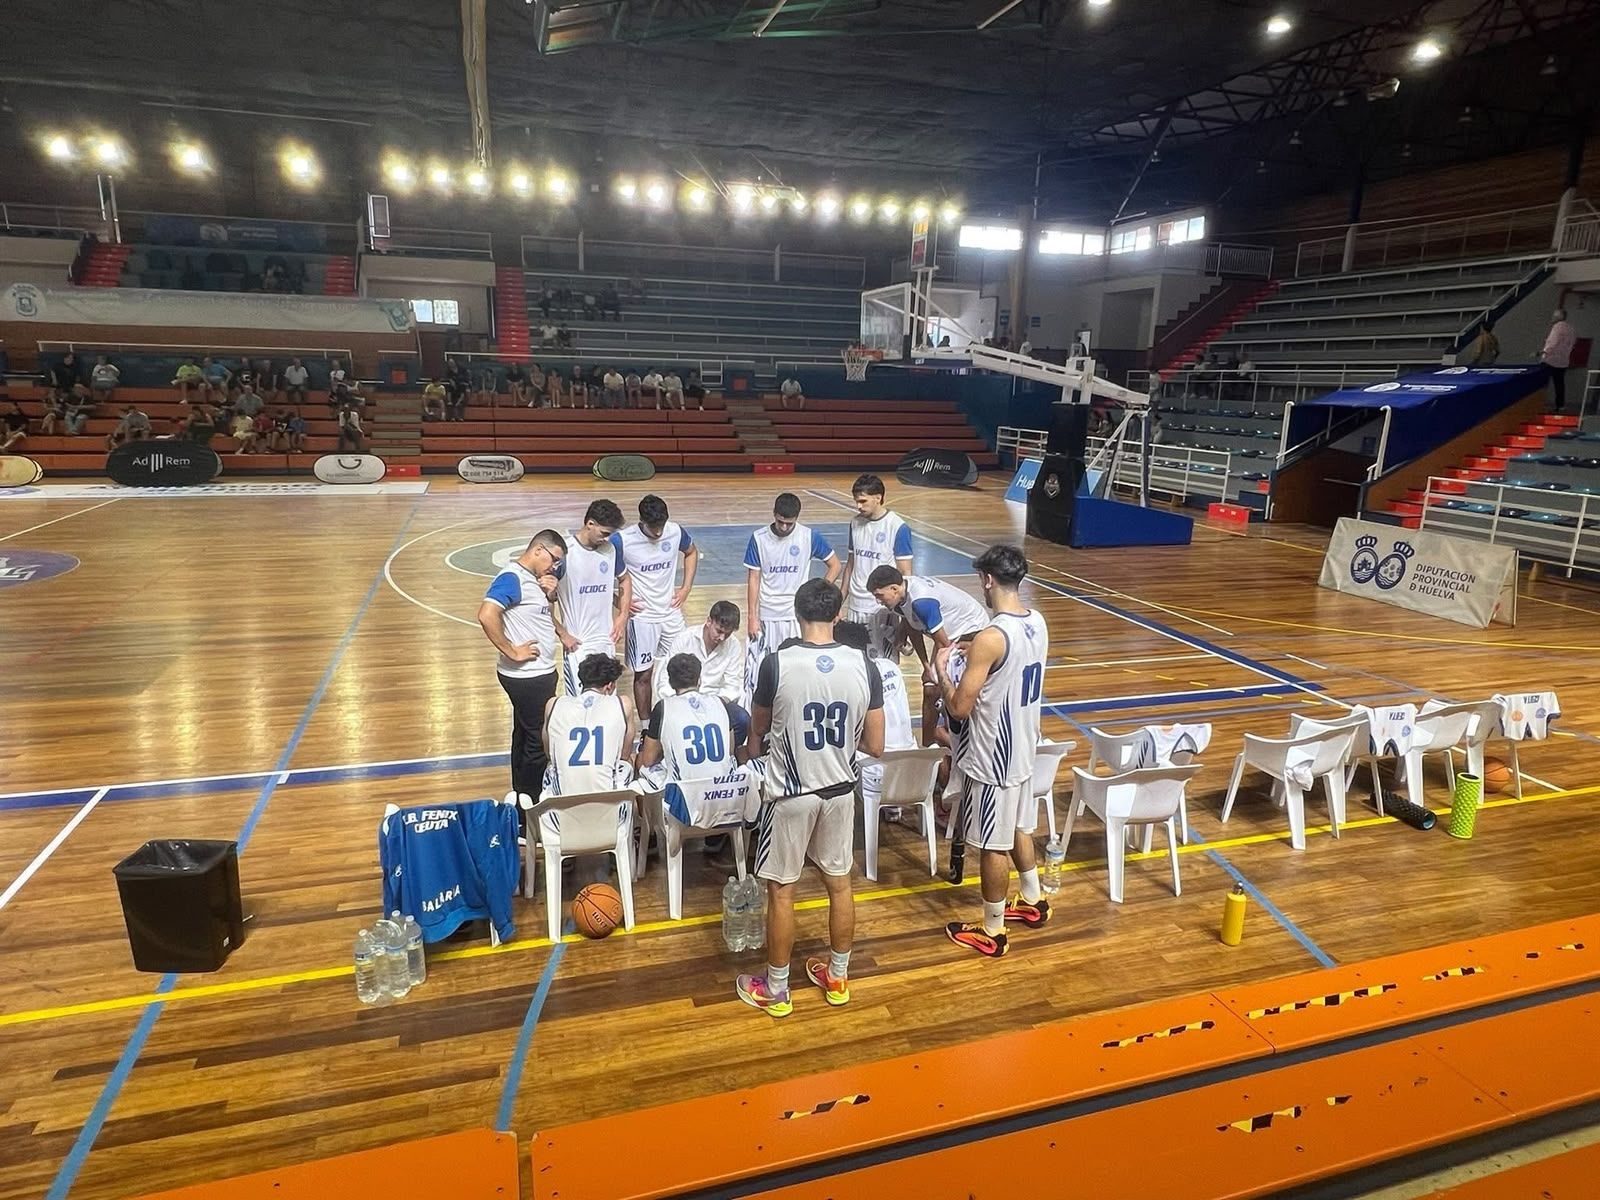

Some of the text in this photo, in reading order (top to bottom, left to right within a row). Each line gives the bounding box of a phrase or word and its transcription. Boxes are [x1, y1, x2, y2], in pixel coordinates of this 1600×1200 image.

[132, 456, 191, 465] Ad Rem
[934, 462, 951, 470] Rem
[1016, 475, 1035, 490] Hue
[1413, 574, 1471, 593] PROVINCIAL
[1419, 585, 1455, 600] HUELVA
[641, 652, 652, 664] 23
[1020, 661, 1042, 708] 10
[803, 701, 849, 751] 33
[568, 725, 605, 767] 21
[682, 722, 726, 766] 30
[713, 773, 747, 785] CEUTA
[703, 788, 734, 801] FENIX
[421, 810, 458, 821] FENIX
[414, 819, 448, 833] CEUTA
